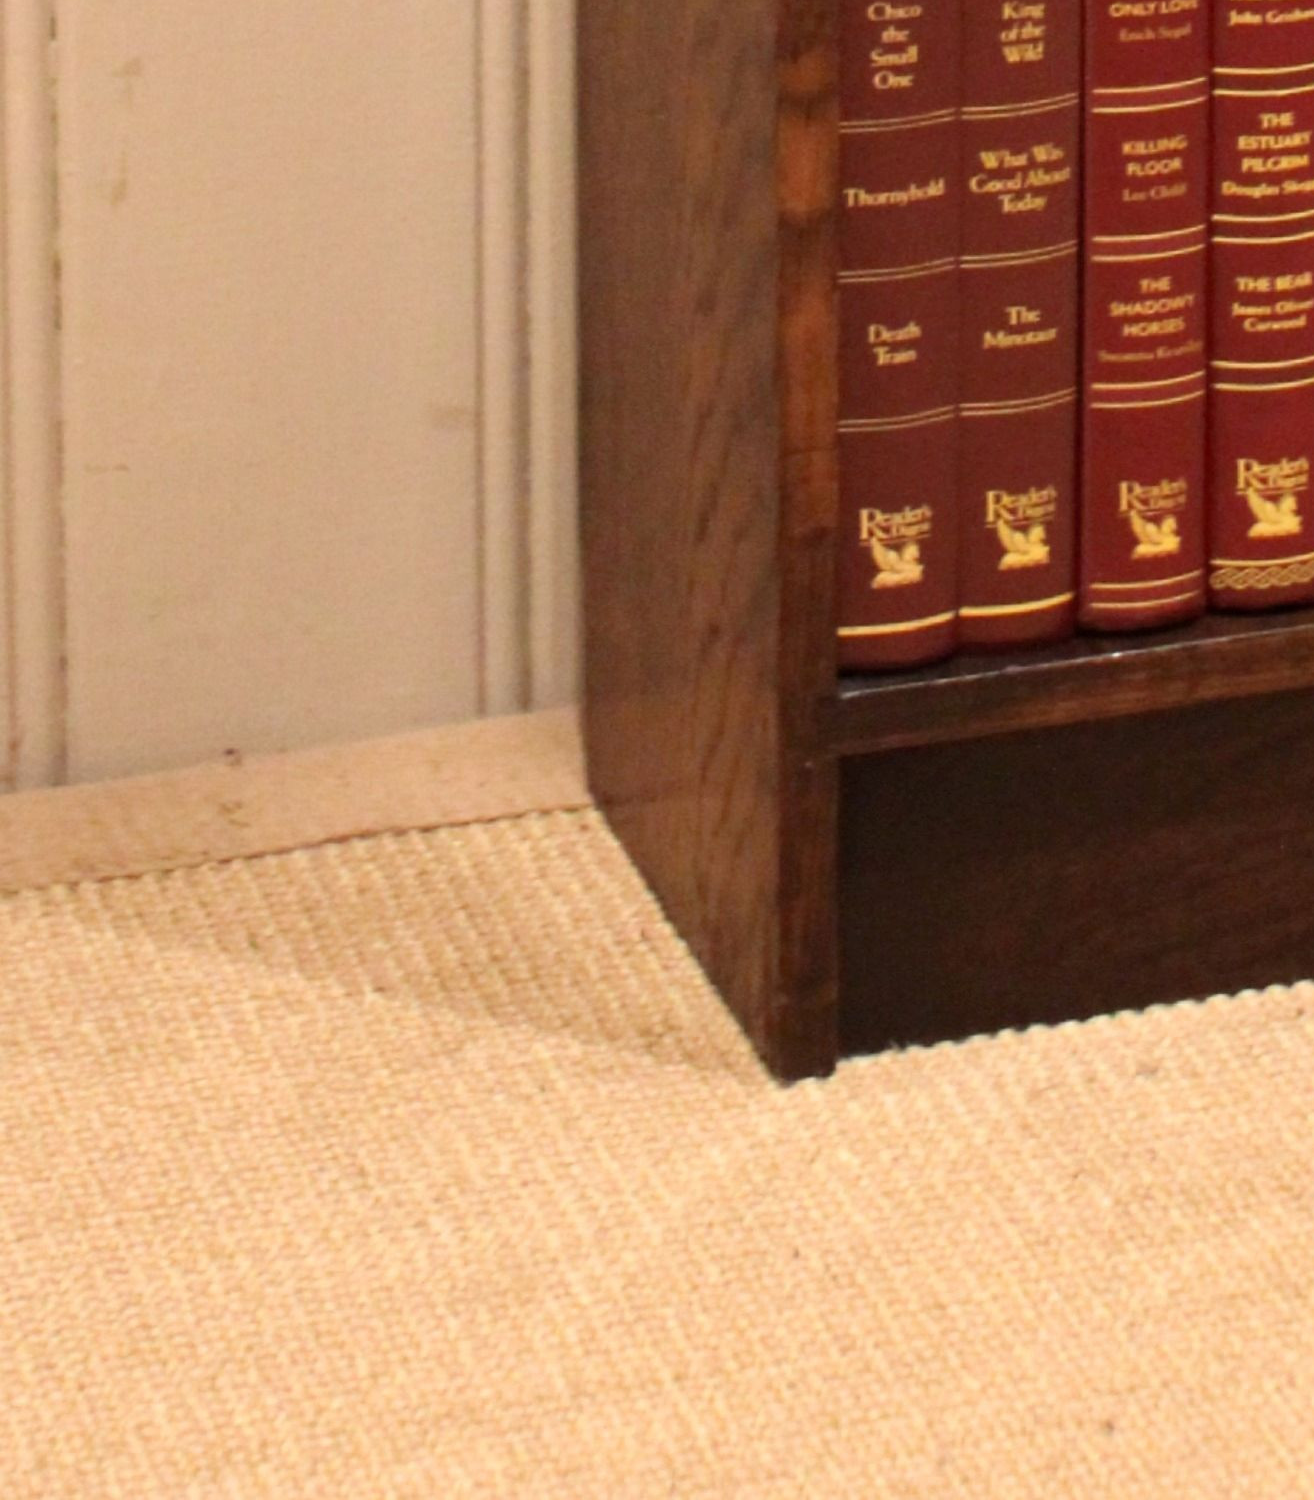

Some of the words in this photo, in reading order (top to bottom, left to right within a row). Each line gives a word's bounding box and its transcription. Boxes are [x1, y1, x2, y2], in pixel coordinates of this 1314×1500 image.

[1002, 1, 1046, 20] King
[1109, 2, 1156, 18] ONLY
[873, 71, 915, 89] One
[1259, 112, 1295, 129] THE
[1121, 134, 1188, 156] KILLING
[980, 151, 1028, 170] What
[843, 178, 945, 207] Thornyhold
[969, 174, 1022, 193] Good
[998, 194, 1048, 214] Today
[1139, 276, 1173, 293] THE
[1236, 276, 1272, 292] THE
[1005, 305, 1042, 325] The
[868, 322, 922, 344] Death
